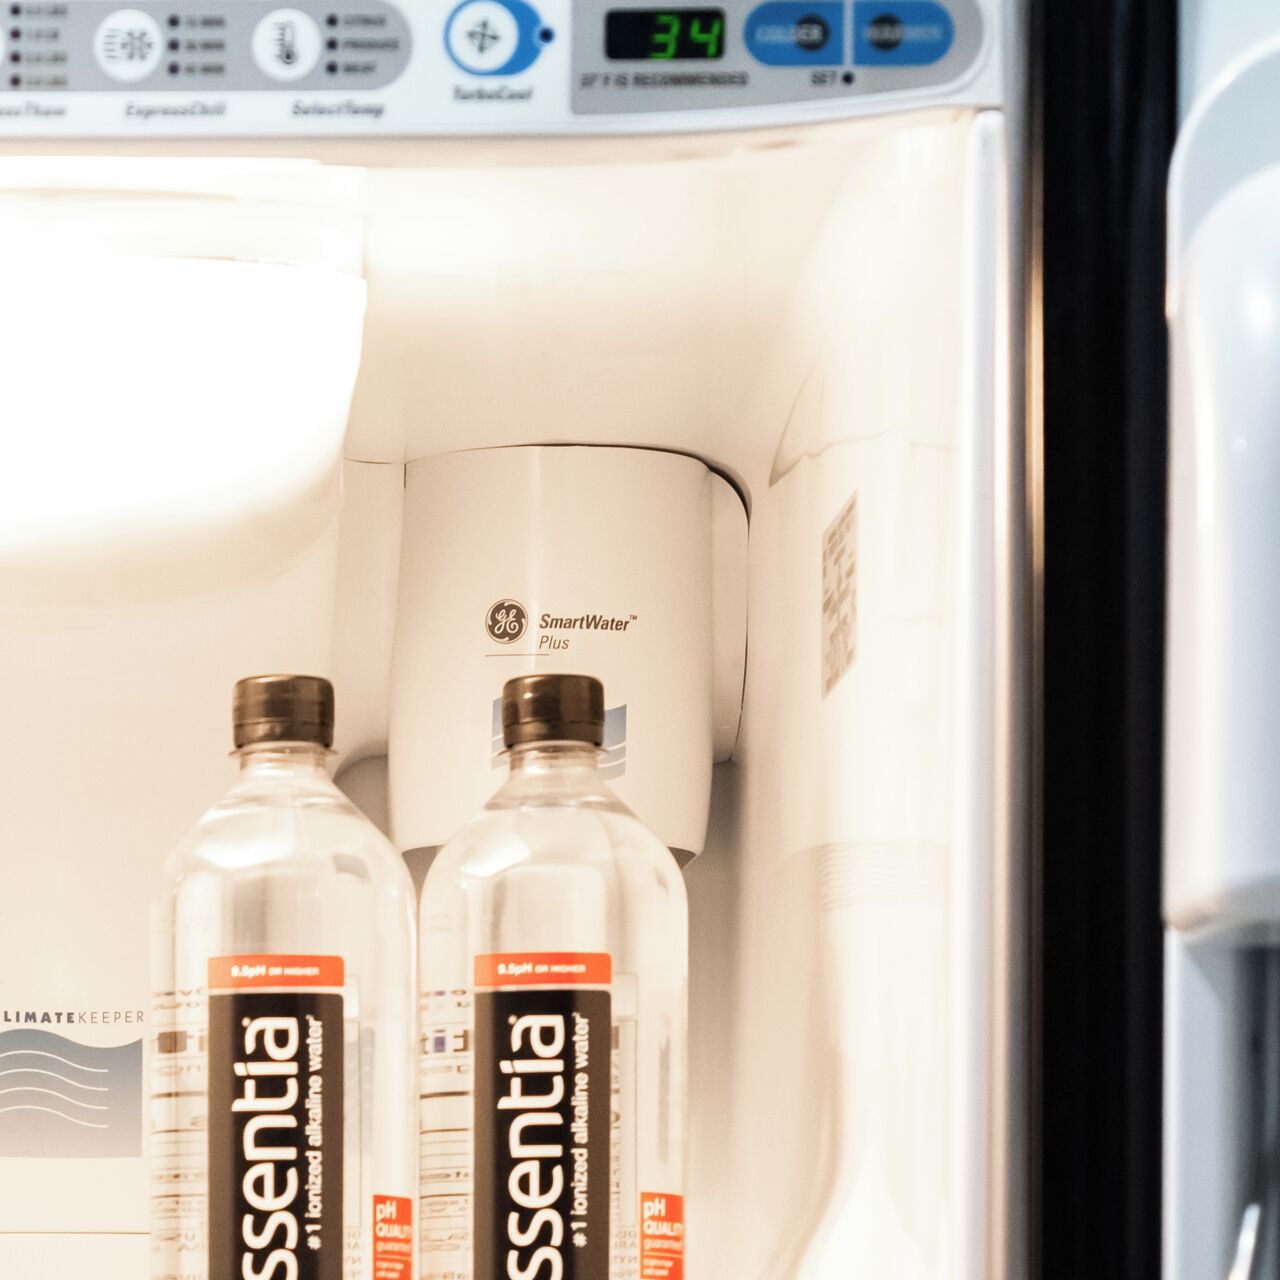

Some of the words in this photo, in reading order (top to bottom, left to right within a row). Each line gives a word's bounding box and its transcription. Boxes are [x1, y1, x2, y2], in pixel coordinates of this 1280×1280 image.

[650, 14, 722, 61] 34
[632, 72, 750, 88] RECOMMENDED
[810, 71, 839, 86] SET
[538, 634, 570, 650] Plus
[304, 1074, 323, 1147] alkaline
[570, 1071, 589, 1144] alkaline
[304, 1150, 322, 1218] ionized
[570, 1148, 589, 1216] ionized
[376, 1199, 397, 1222] pH
[643, 1197, 667, 1220] pH
[305, 1223, 322, 1250] #1
[570, 1221, 588, 1248] #1
